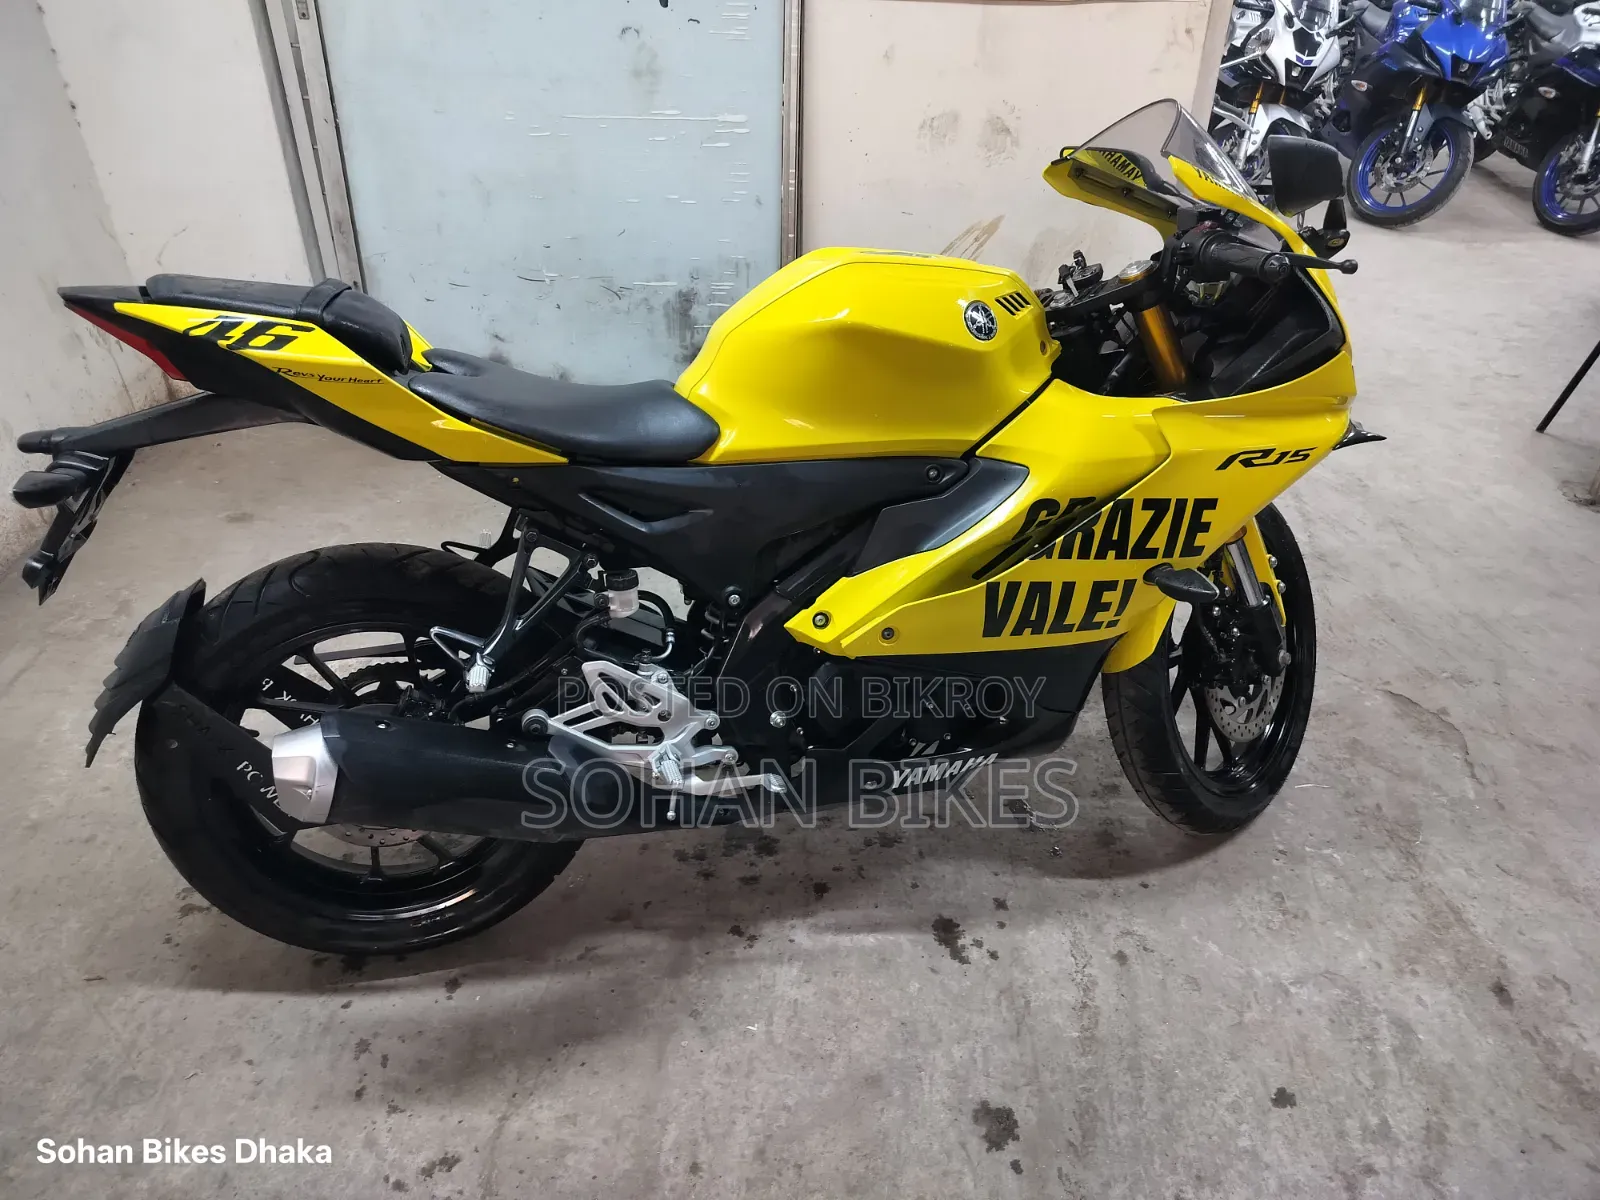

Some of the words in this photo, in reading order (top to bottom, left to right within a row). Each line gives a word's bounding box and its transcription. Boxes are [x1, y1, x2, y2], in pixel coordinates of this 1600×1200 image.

[272, 366, 315, 378] Revs
[316, 374, 348, 382] Your
[1215, 447, 1317, 471] R15
[1010, 496, 1218, 561] GRAZIE
[982, 578, 1137, 638] VALE!
[892, 752, 999, 789] YAMAHA
